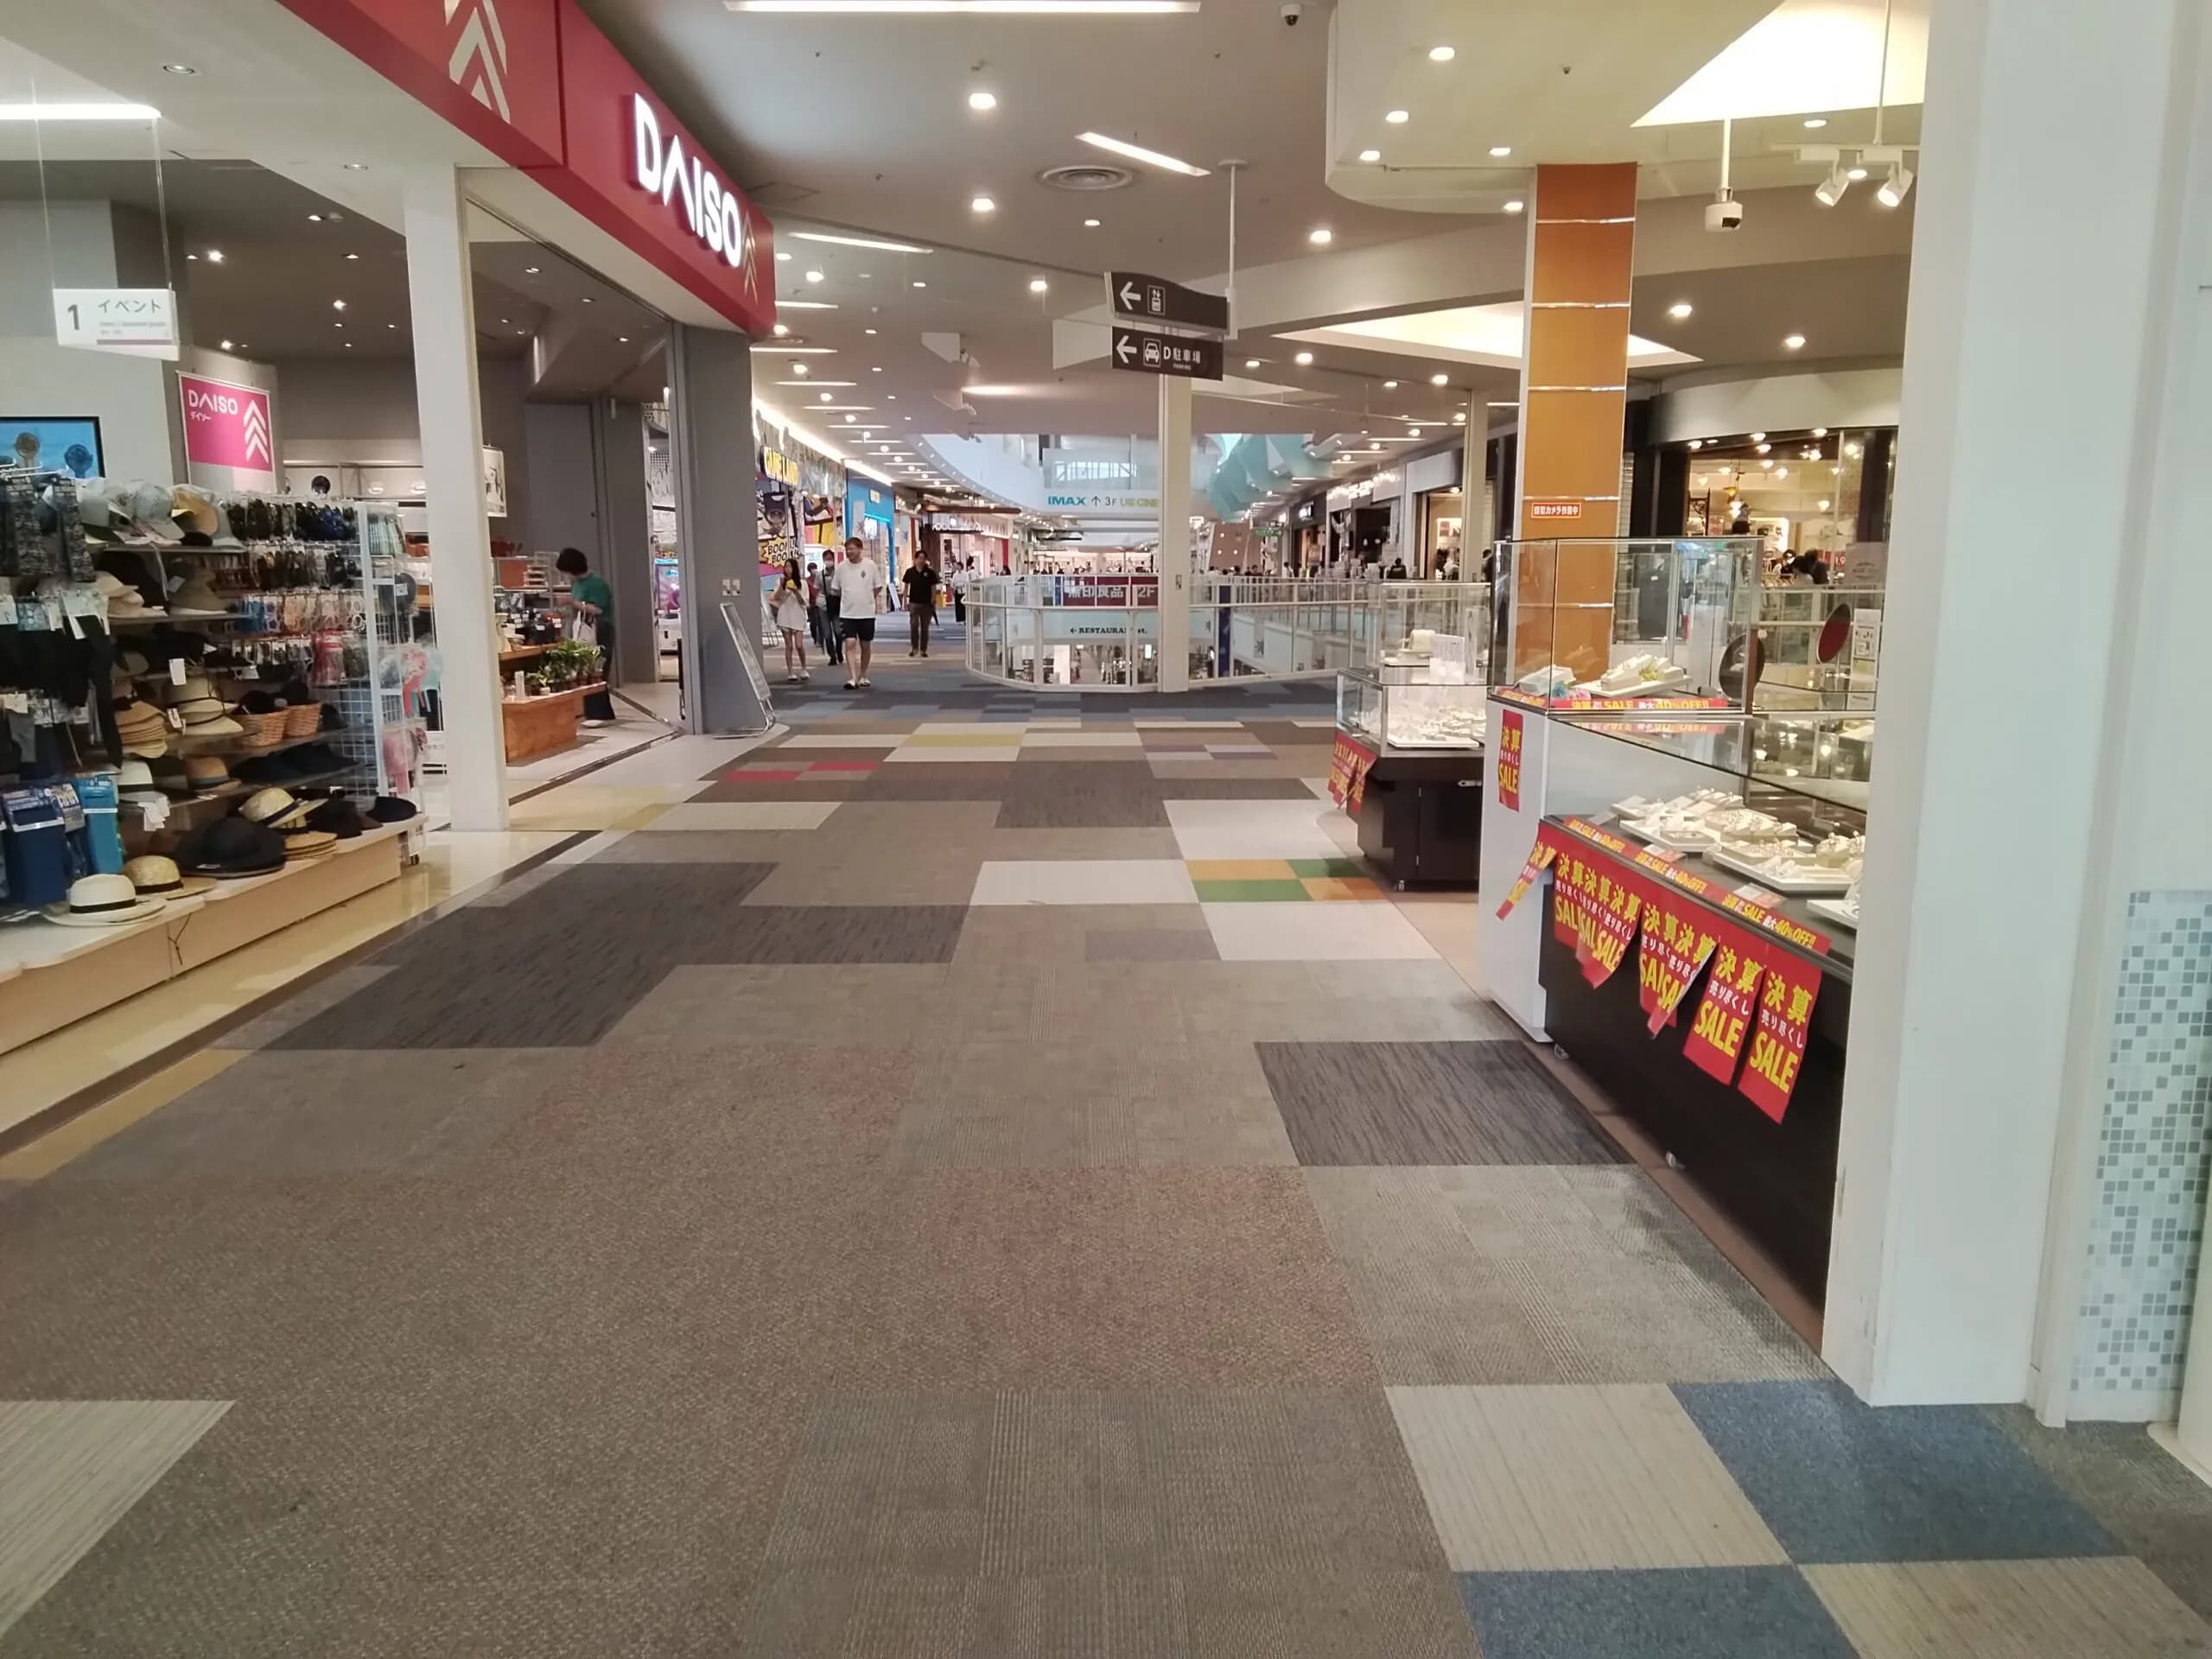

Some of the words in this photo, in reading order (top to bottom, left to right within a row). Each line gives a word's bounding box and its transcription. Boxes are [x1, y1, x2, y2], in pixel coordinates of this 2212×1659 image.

[634, 92, 741, 267] DAISO
[67, 304, 79, 331] 1
[98, 299, 162, 314] イベント
[188, 389, 238, 415] DAISO
[190, 411, 212, 422] ダイソー
[1048, 496, 1085, 506] IMAX
[1105, 497, 1119, 506] 3F
[1068, 586, 1123, 599] 無印良品
[1138, 587, 1155, 598] 2F
[1603, 701, 1633, 709] SALE
[1498, 763, 1518, 794] SALE
[1558, 853, 1585, 887] 決算
[1585, 868, 1612, 905] 決算
[1610, 884, 1641, 923] 決算
[1741, 903, 1765, 924] SALE
[1578, 907, 1599, 950] SAL
[1604, 912, 1632, 941] 売り尽くし
[1643, 902, 1679, 945] 決算
[1592, 930, 1626, 973] SALE
[1642, 934, 1671, 958] 売り尽く
[1675, 922, 1716, 964] 決算
[1669, 955, 1696, 979] 売り尽く
[1715, 945, 1764, 994] 決算
[1657, 974, 1685, 1013] SA
[1708, 980, 1750, 1015] 売り尽くし
[1764, 971, 1813, 1026] 決算
[1694, 1000, 1744, 1058] SALE
[1762, 1008, 1804, 1049] 売り尽くし
[1749, 1031, 1798, 1094] SALE
